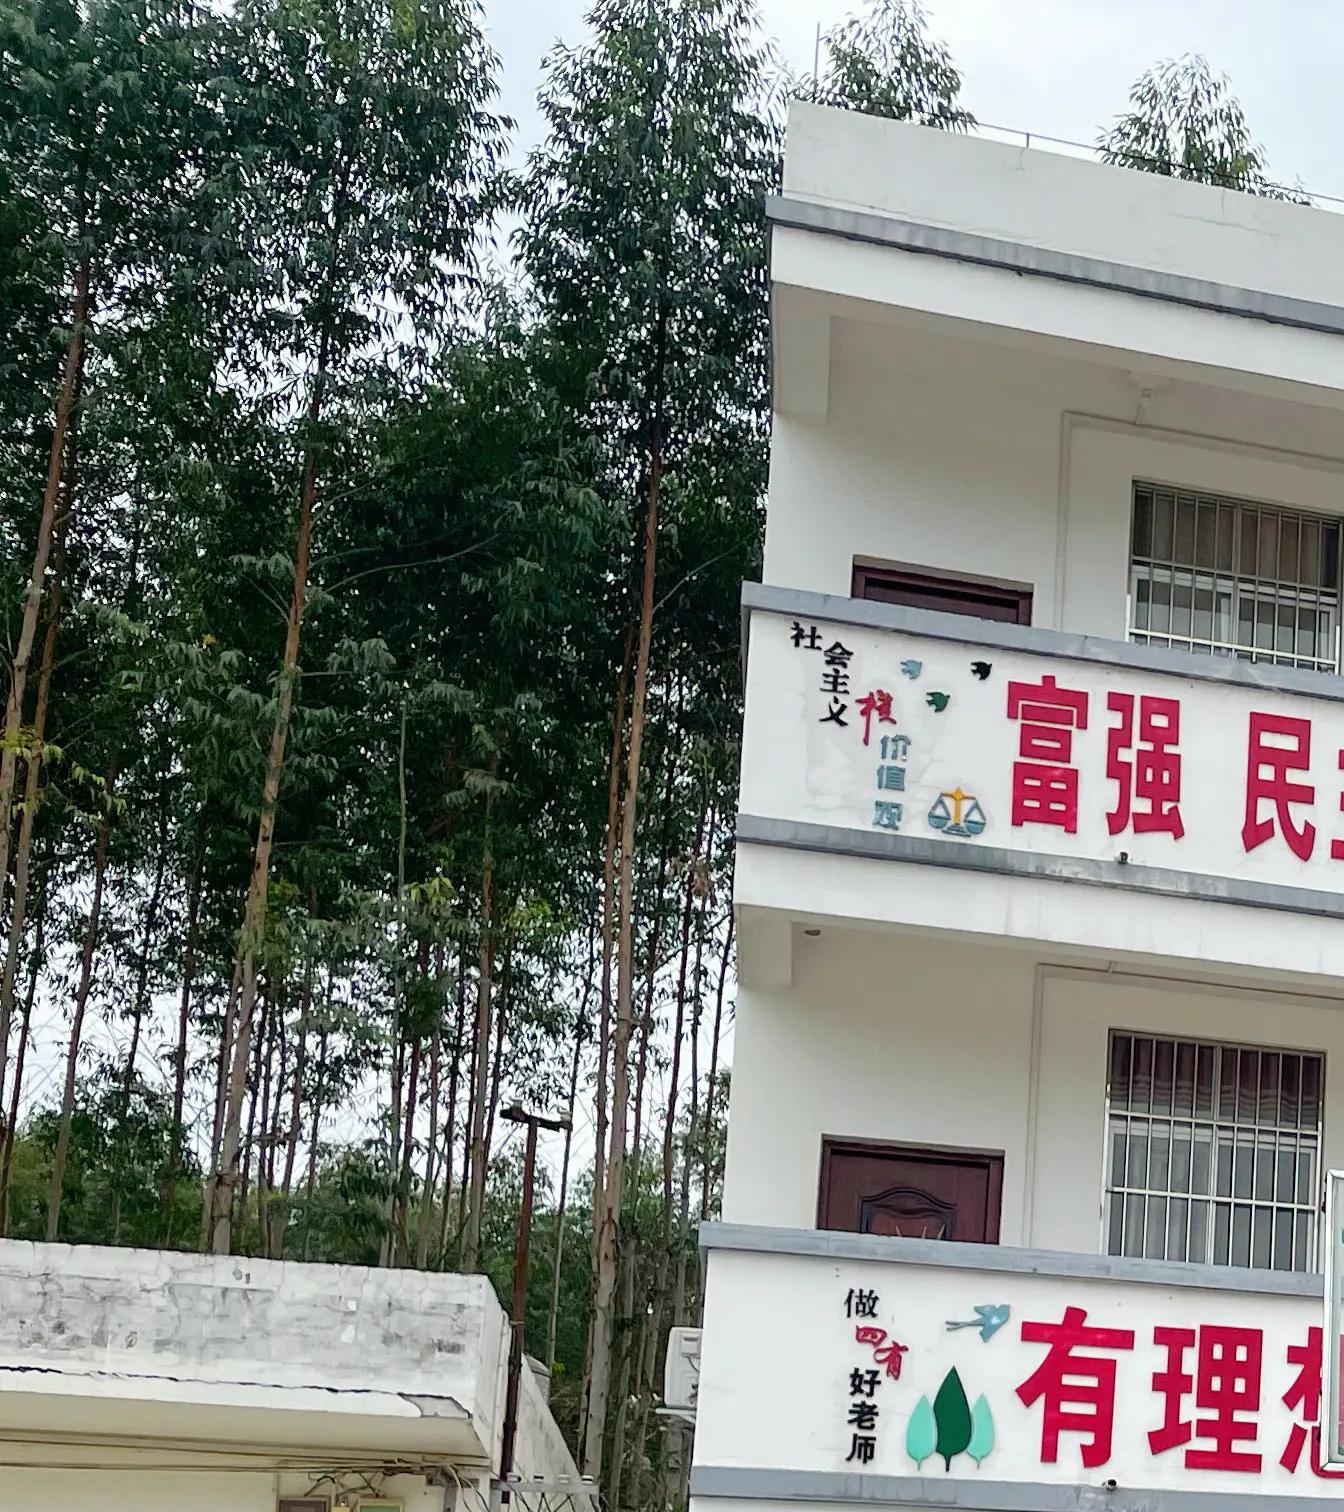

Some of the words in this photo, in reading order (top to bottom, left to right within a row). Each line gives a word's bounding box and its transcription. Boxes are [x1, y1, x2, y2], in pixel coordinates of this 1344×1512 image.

[789, 621, 854, 727] 社会主义
[1007, 675, 1184, 839] 富强
